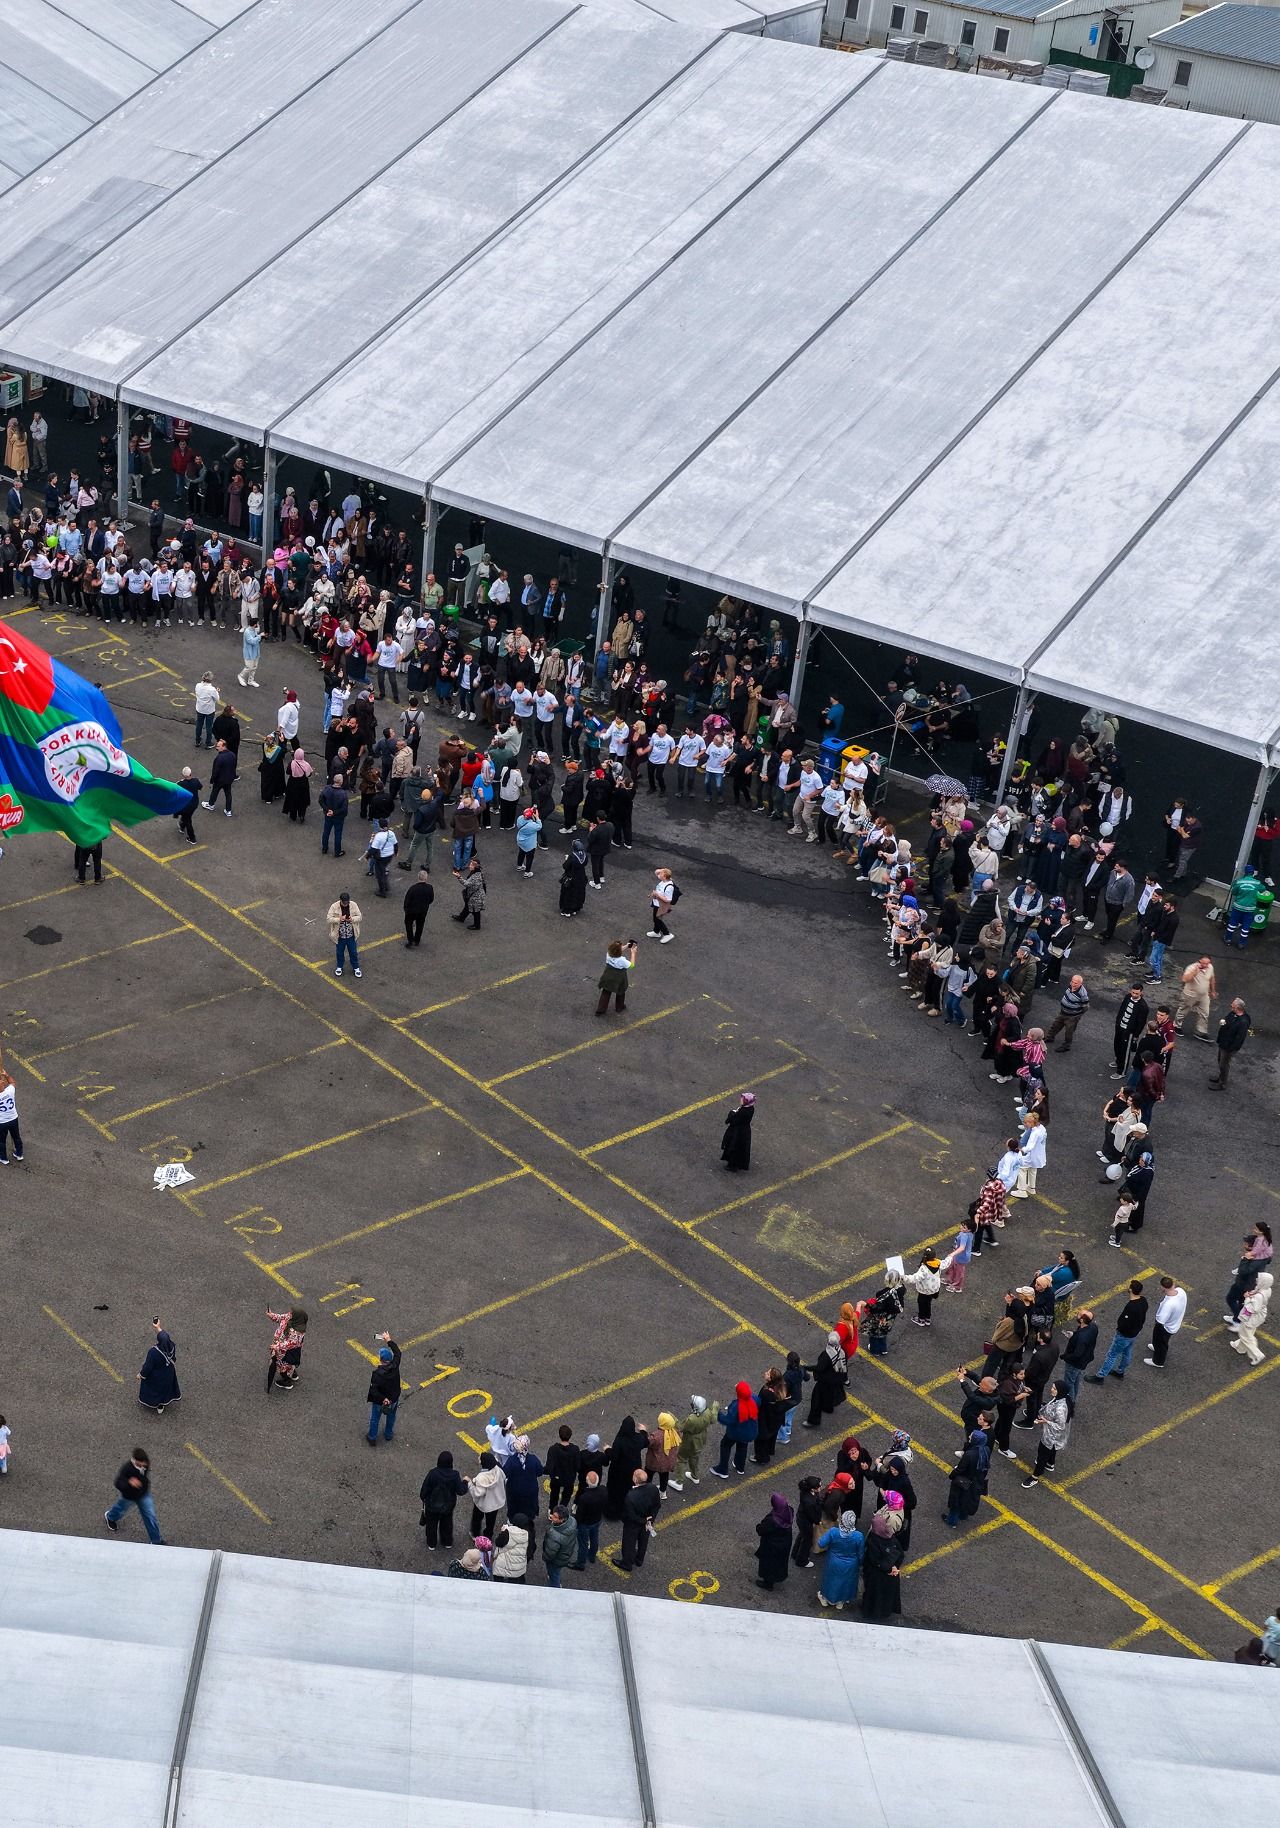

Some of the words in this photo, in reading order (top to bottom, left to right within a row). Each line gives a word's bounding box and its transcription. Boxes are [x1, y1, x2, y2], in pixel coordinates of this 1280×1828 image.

[223, 1205, 283, 1244] 12
[420, 1363, 493, 1419] 10
[668, 1570, 721, 1603] 8
